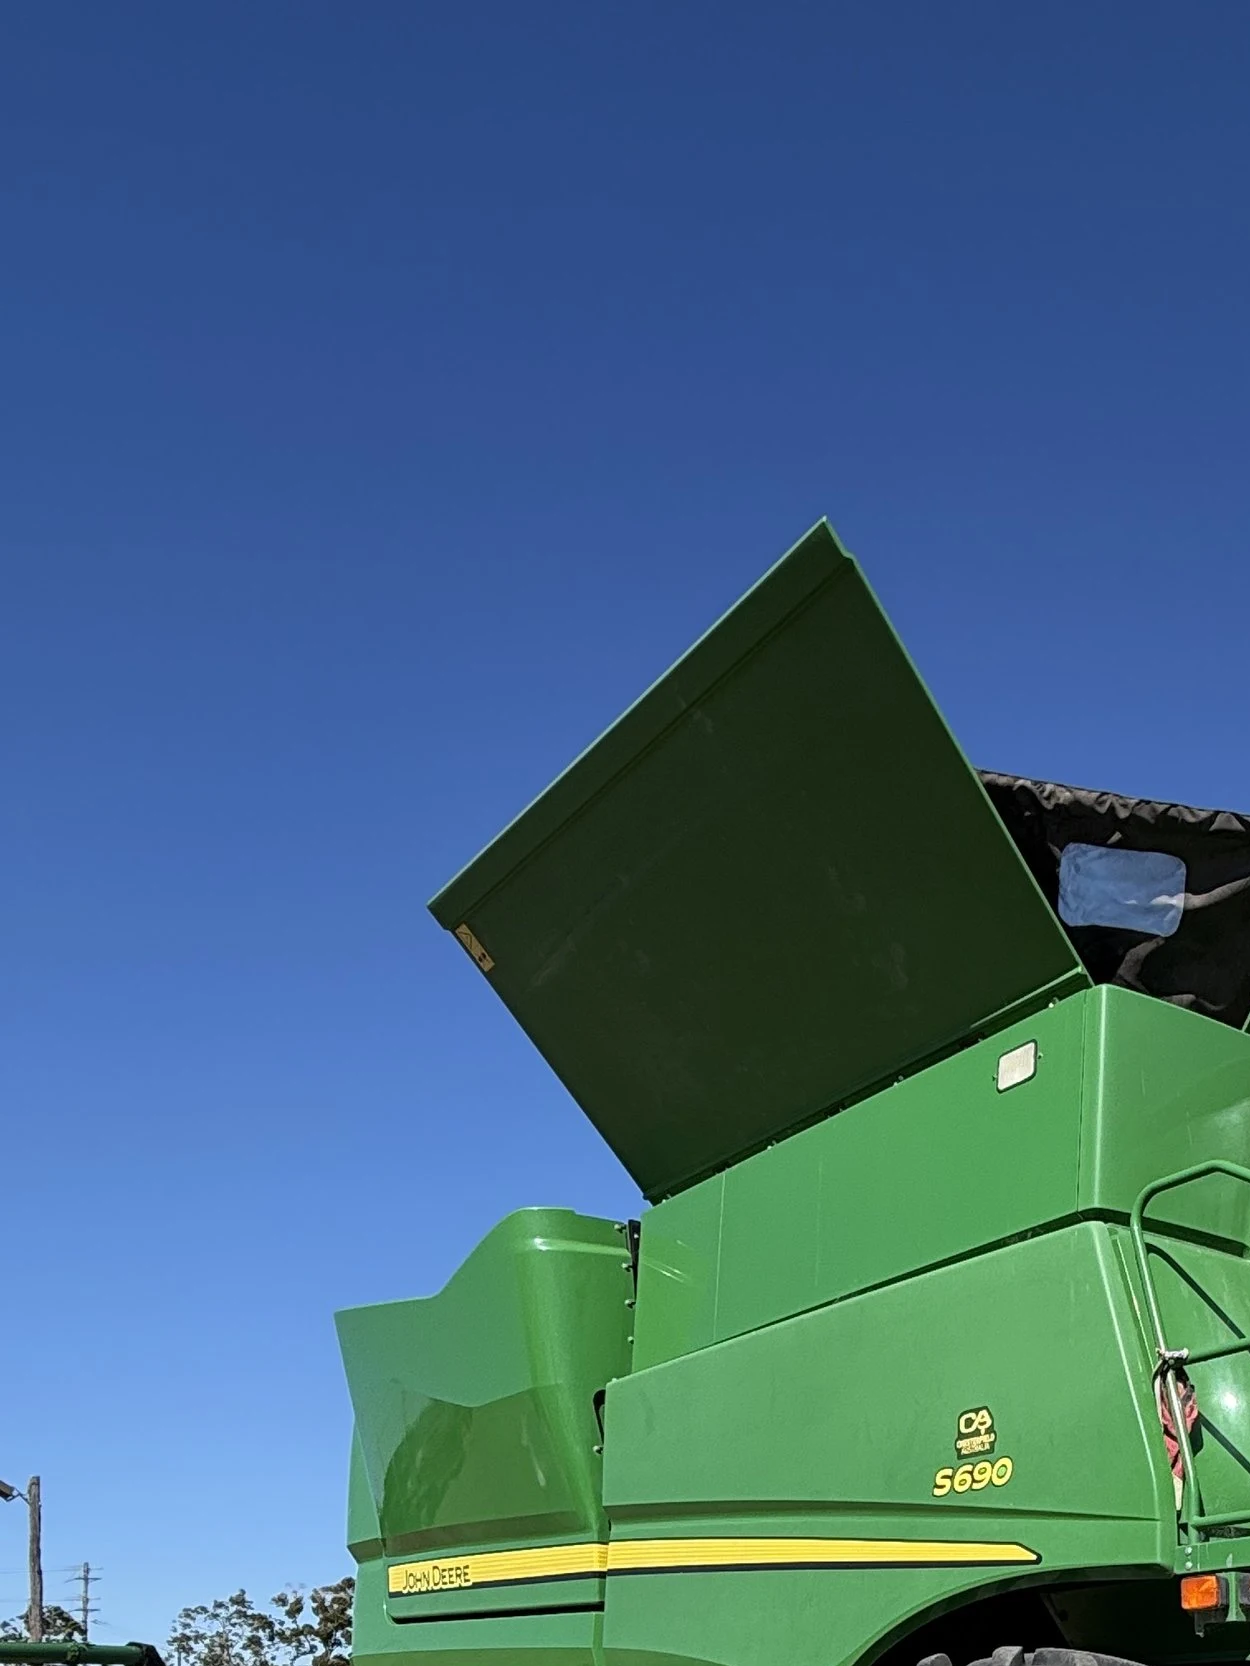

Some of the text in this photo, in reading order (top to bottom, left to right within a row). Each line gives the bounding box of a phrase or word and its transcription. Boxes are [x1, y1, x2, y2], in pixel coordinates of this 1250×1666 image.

[932, 1456, 1013, 1496] S690
[403, 1565, 471, 1591] JOHN DEERE
